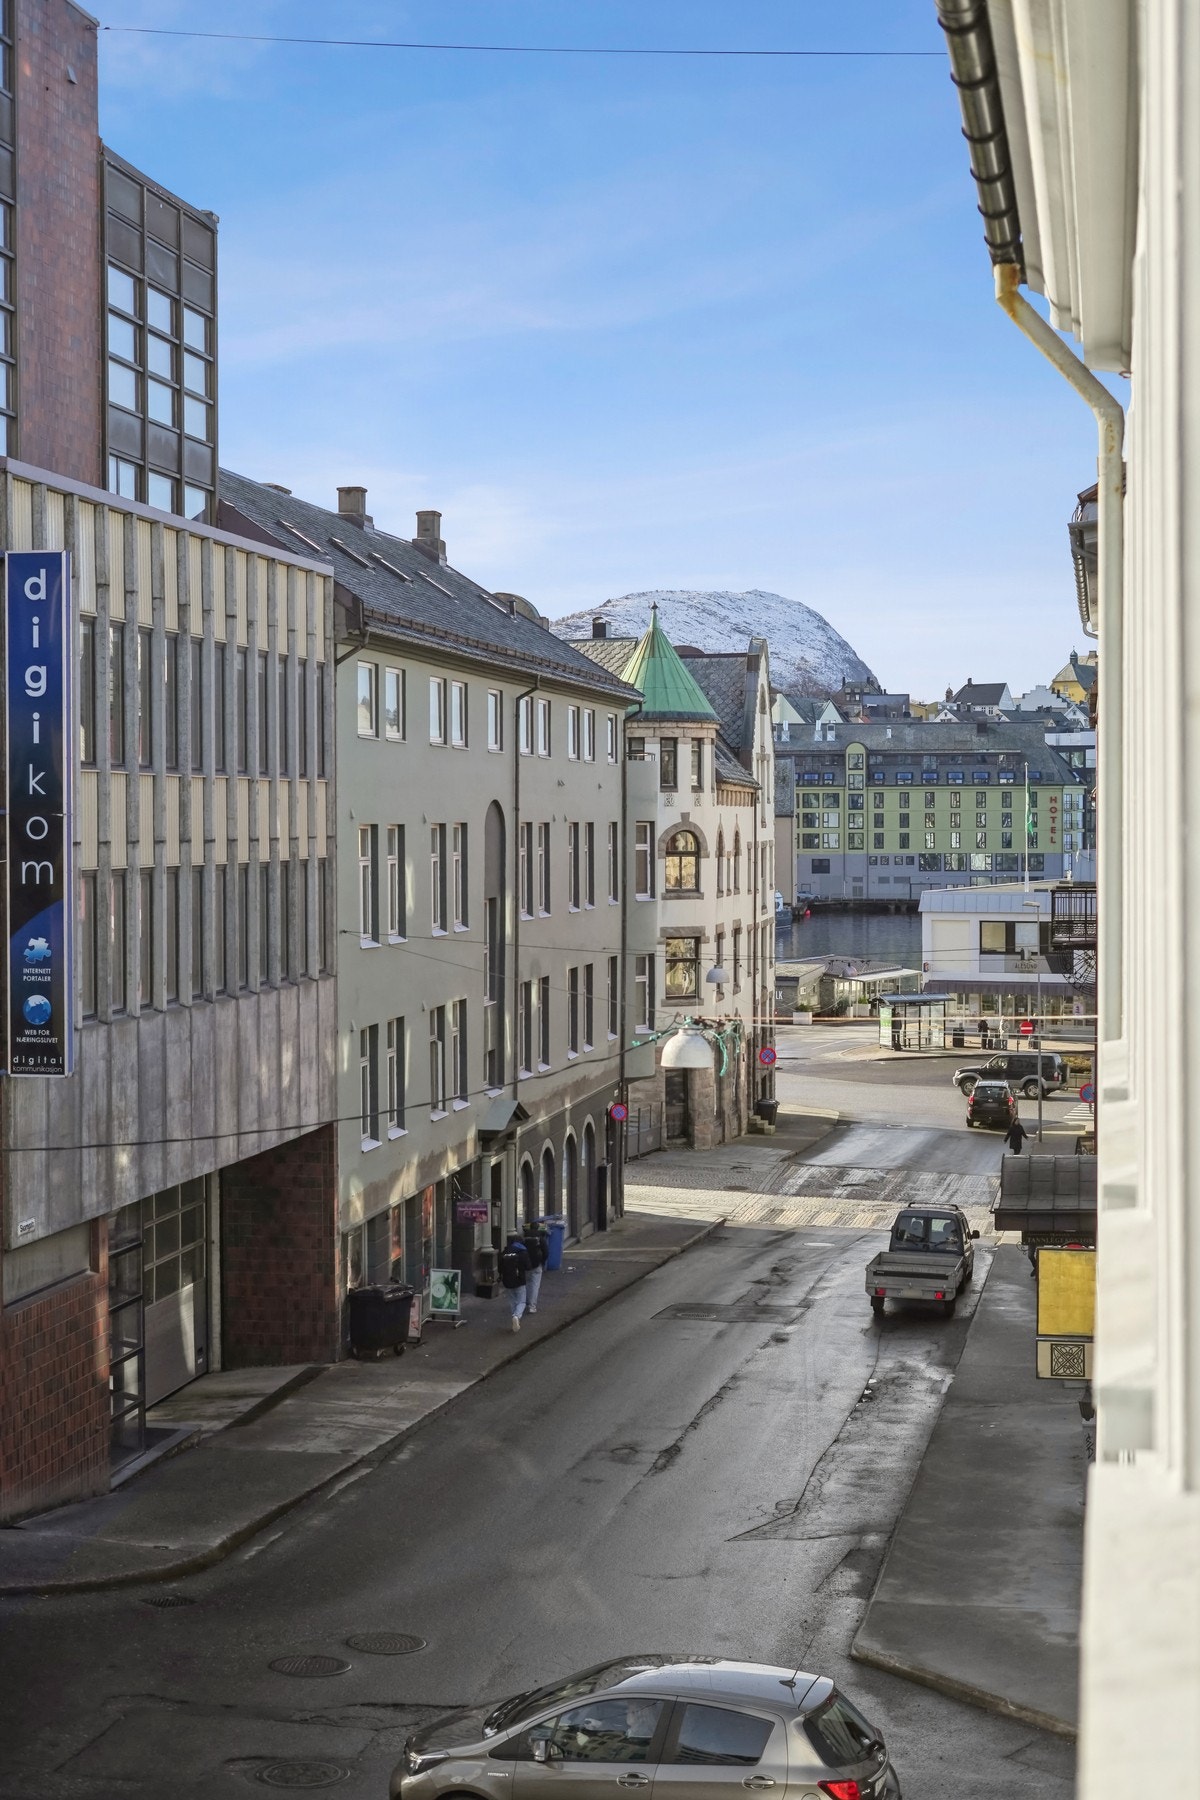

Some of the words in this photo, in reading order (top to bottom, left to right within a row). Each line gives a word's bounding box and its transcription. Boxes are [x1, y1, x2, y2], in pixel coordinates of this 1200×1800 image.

[22, 568, 54, 885] digikom
[1049, 796, 1058, 844] HOTEL
[13, 1055, 63, 1065] digital
